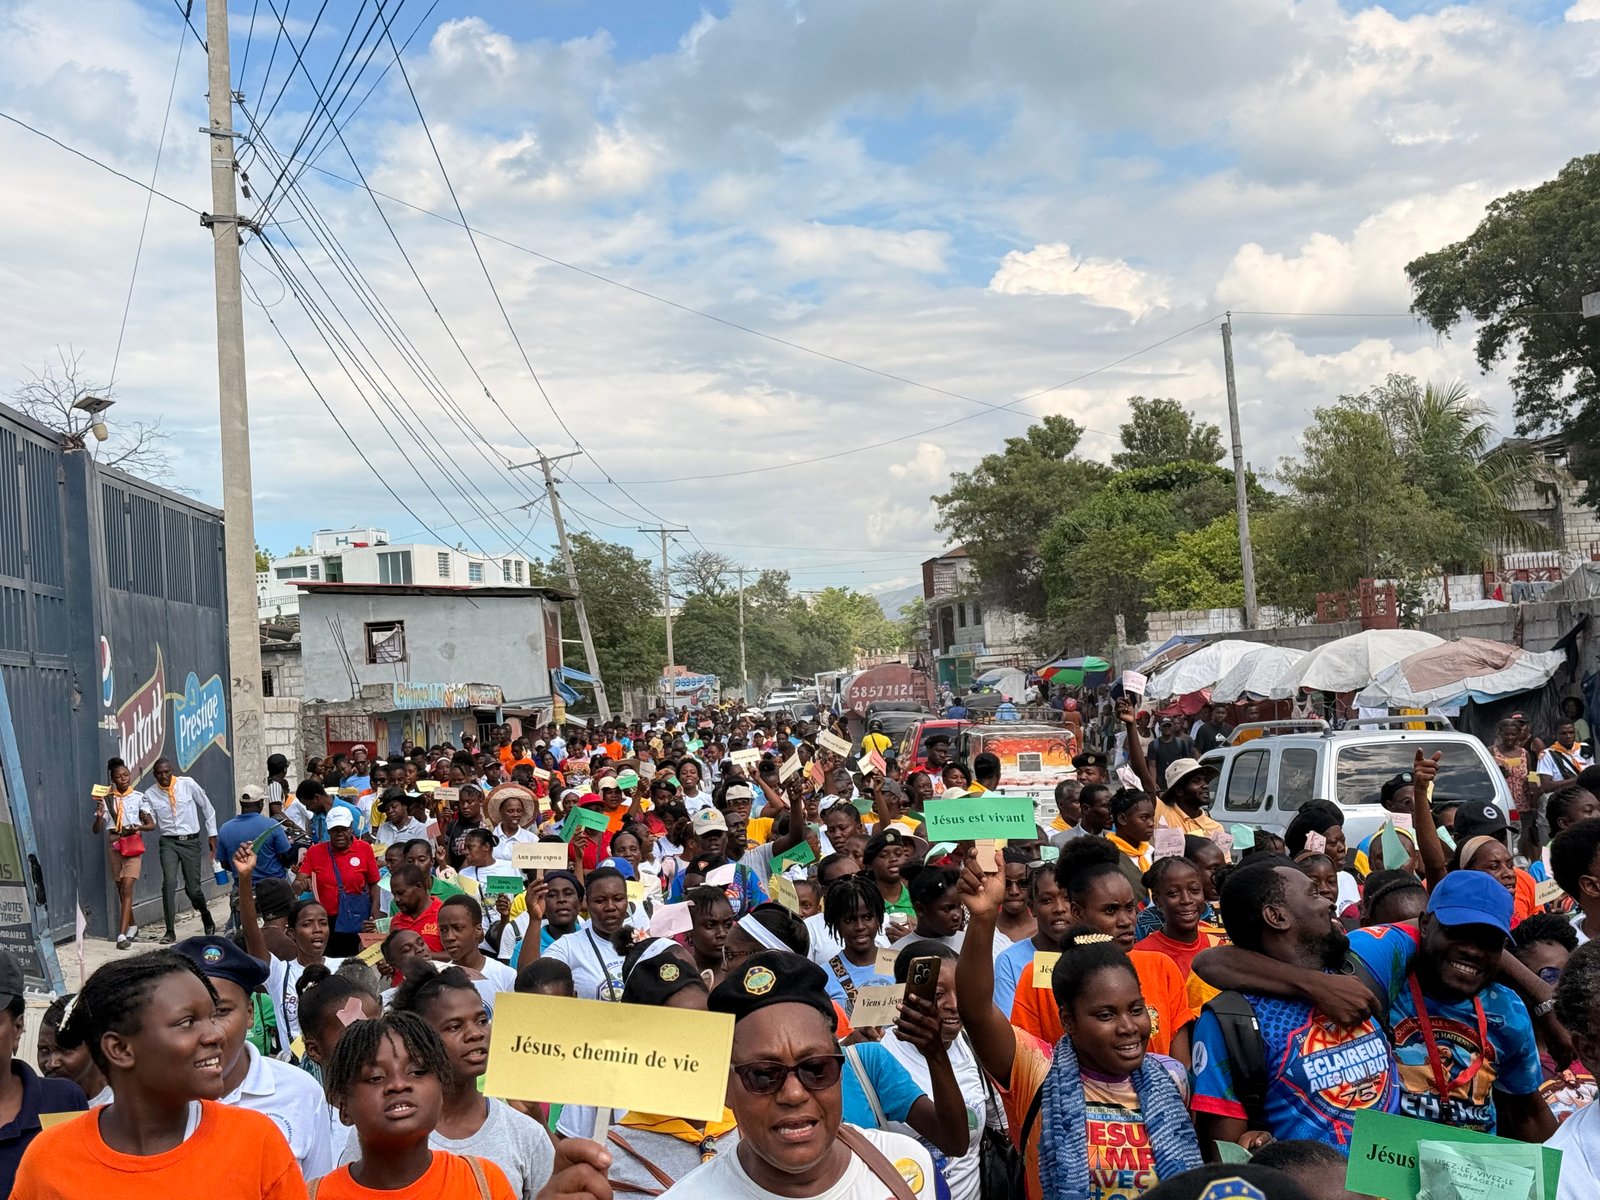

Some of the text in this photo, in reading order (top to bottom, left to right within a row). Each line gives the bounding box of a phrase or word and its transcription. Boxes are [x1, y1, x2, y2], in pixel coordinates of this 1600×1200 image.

[179, 692, 219, 753] Prestige
[932, 812, 1026, 826] Jésus est vivant
[0, 913, 21, 922] TURES
[1040, 965, 1052, 973] Jés
[862, 998, 880, 1007] Viens
[887, 996, 903, 1006] Jésu
[510, 1035, 699, 1072] Jésus, chemin de vie
[1302, 1038, 1386, 1080] ÉCLAIREUR
[1310, 1072, 1342, 1094] AVEC
[1344, 1062, 1367, 1083] UN
[1368, 1054, 1389, 1080] BUT
[1340, 1084, 1377, 1108] 75
[1086, 1121, 1148, 1148] ESU
[1366, 1143, 1416, 1169] Jésus
[1089, 1169, 1150, 1188] AVEC
[1477, 1170, 1514, 1186] VIVEZ-LE
